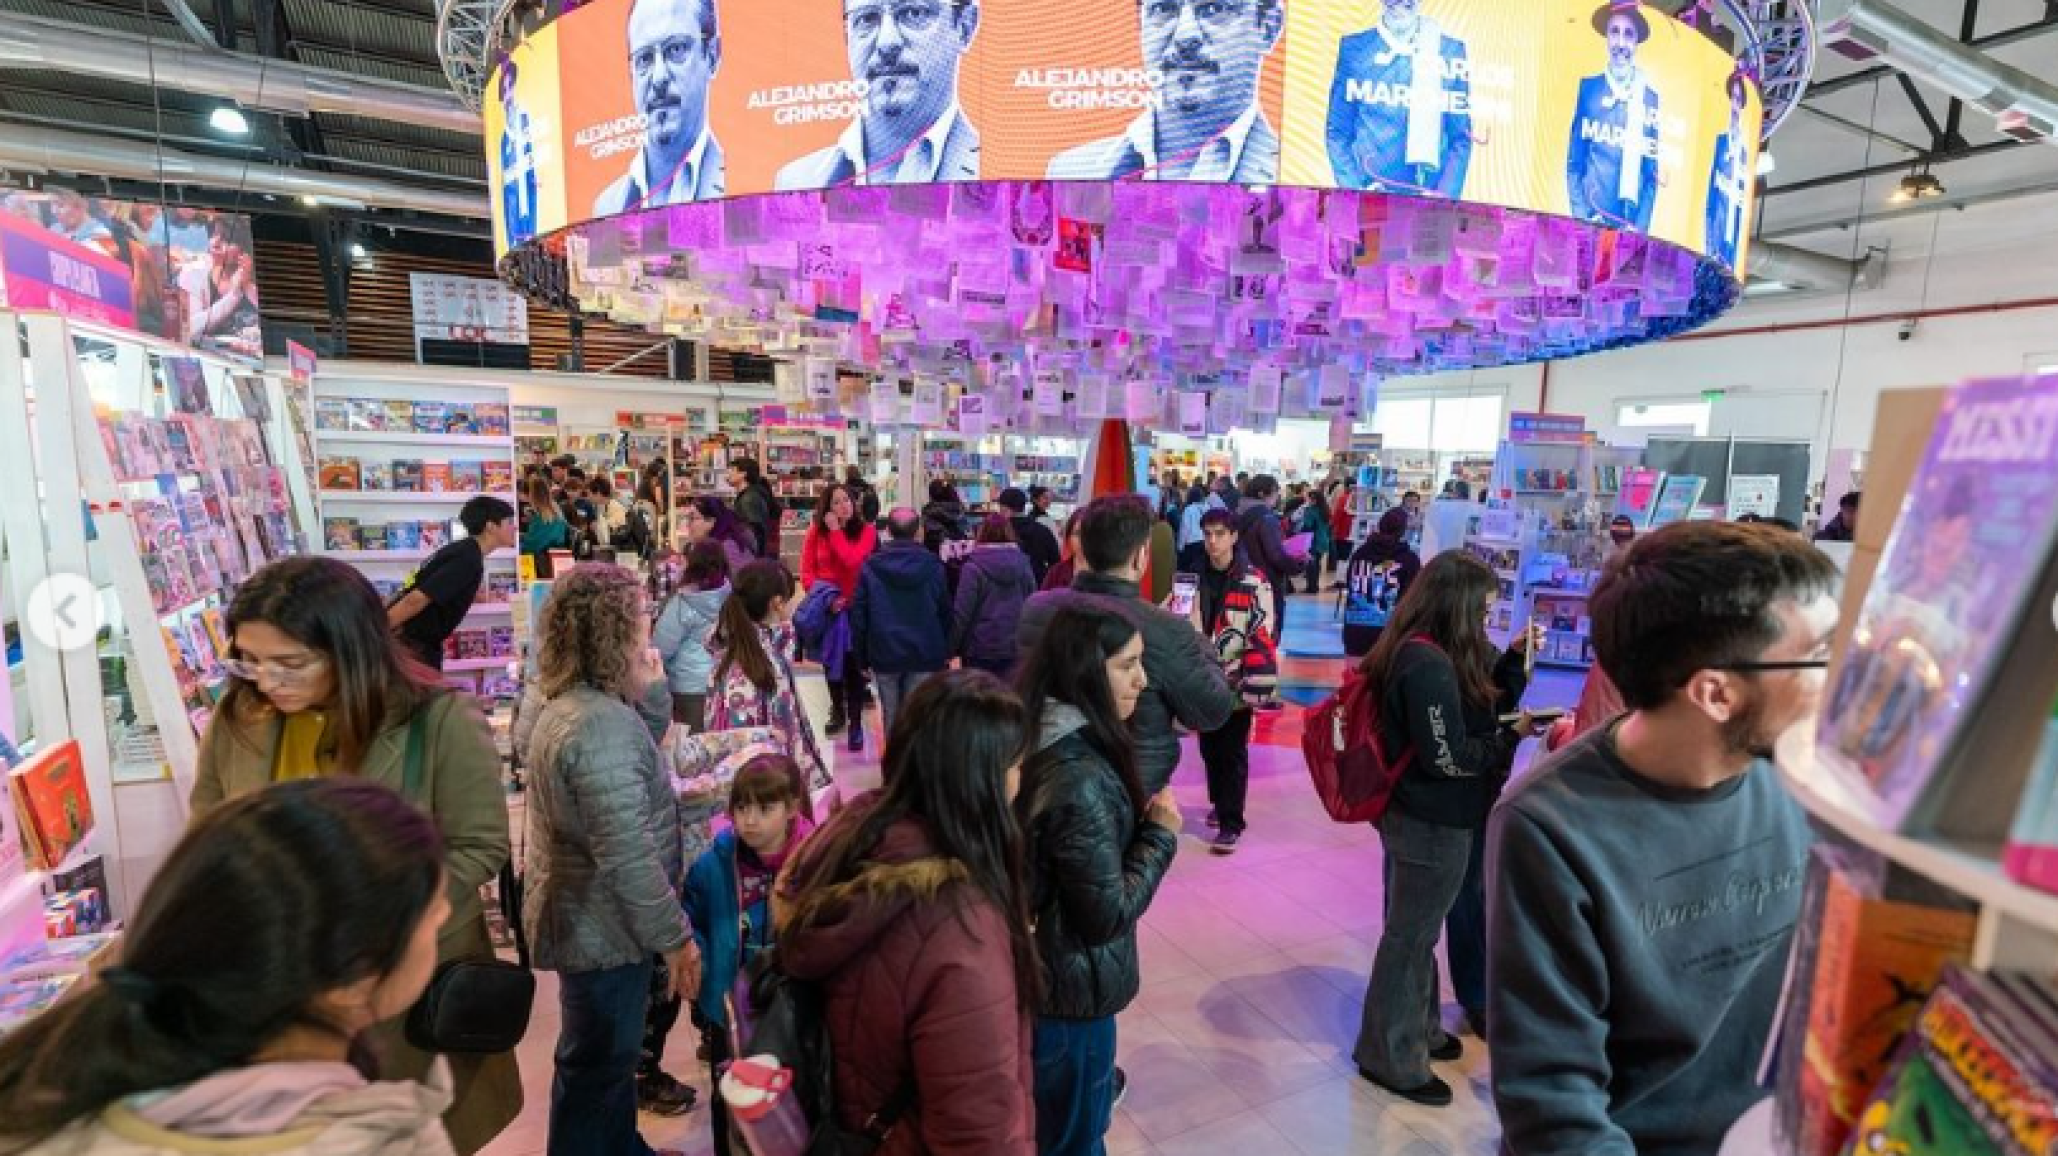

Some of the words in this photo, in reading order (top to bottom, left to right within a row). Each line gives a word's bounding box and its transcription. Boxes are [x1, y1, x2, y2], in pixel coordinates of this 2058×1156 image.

[1014, 66, 1163, 87] ALEJANDRO
[747, 79, 868, 109] ALEJANDRO
[1048, 88, 1164, 110] GRIMSON
[774, 98, 868, 125] GRIMSON
[573, 114, 648, 148] ALEJANDRO
[589, 131, 648, 160] GRIMSON
